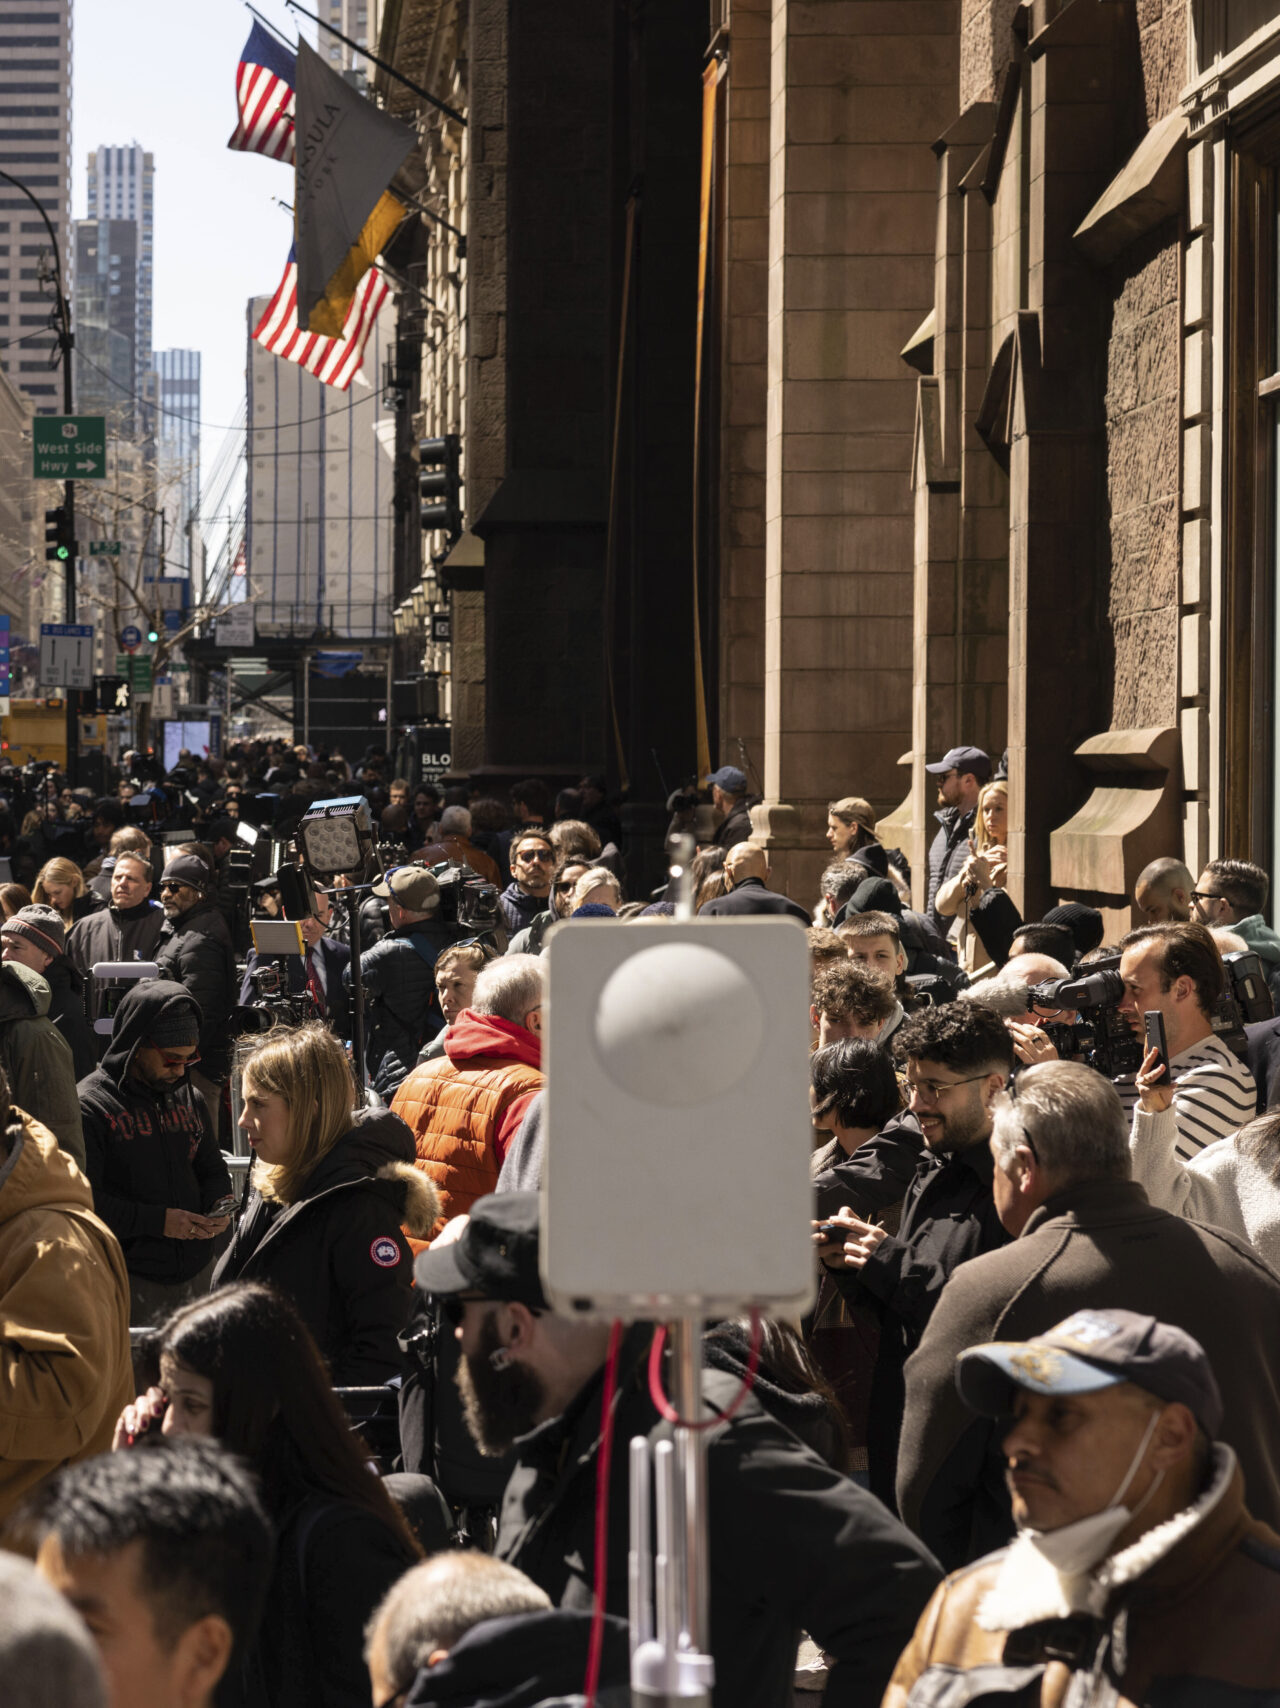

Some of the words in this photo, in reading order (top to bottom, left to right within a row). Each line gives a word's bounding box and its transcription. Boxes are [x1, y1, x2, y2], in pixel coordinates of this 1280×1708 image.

[37, 443, 69, 454] West
[74, 443, 103, 454] Side
[41, 461, 69, 473] Hwy
[422, 754, 451, 765] BLO
